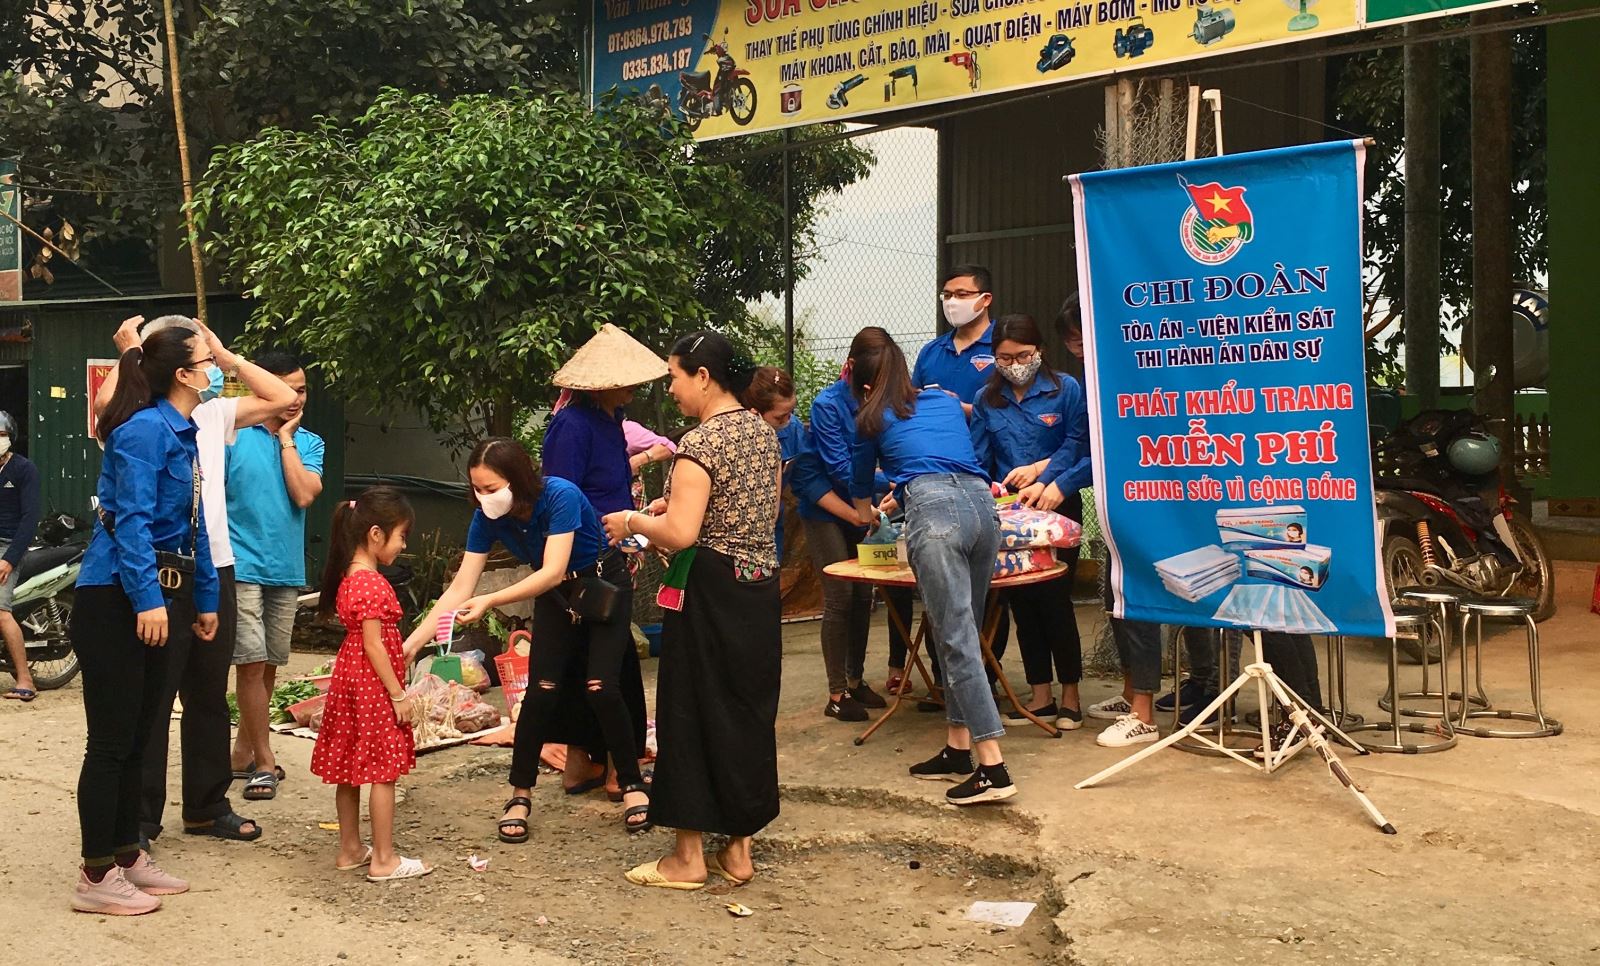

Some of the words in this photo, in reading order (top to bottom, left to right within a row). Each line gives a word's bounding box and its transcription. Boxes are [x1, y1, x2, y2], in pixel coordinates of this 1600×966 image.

[746, 38, 773, 60] THAY
[776, 26, 799, 54] THẾ
[801, 27, 825, 51] PHỤ
[828, 19, 860, 42] TÙNG
[864, 9, 904, 36] CHÍNH
[907, 1, 938, 28] HIỆU
[781, 58, 806, 82] MÁY
[810, 51, 856, 77] KHOAN,
[890, 37, 920, 62] BÀO,
[925, 29, 950, 55] MÀI
[964, 21, 1002, 48] QUẠT
[1006, 12, 1042, 42] ĐIỆN
[1057, 1, 1093, 30] MÁY
[622, 48, 692, 80] 0335.834.187
[1124, 279, 1193, 308] CHI
[1204, 262, 1331, 302] ĐOÀN
[1121, 320, 1155, 343] TÒA
[1158, 317, 1184, 340] ÁN
[1198, 314, 1239, 341] VIỆN
[1244, 307, 1291, 332] KIỂM
[1297, 306, 1335, 330] SÁT
[1136, 350, 1162, 368] THI
[1167, 343, 1215, 367] HÀNH
[1219, 341, 1245, 364] ÁN
[1249, 339, 1288, 362] DÂN
[1294, 337, 1324, 363] SỰ
[1117, 387, 1178, 418] PHÁT
[1186, 379, 1254, 415] KHẨU
[1261, 383, 1353, 413] TRANG
[1138, 419, 1245, 467] MIỄN
[1255, 420, 1337, 465] PHÍ
[1124, 480, 1182, 501] CHUNG
[1187, 475, 1222, 500] SỨC
[1226, 476, 1245, 500] VÌ
[1250, 475, 1301, 505] CỘNG
